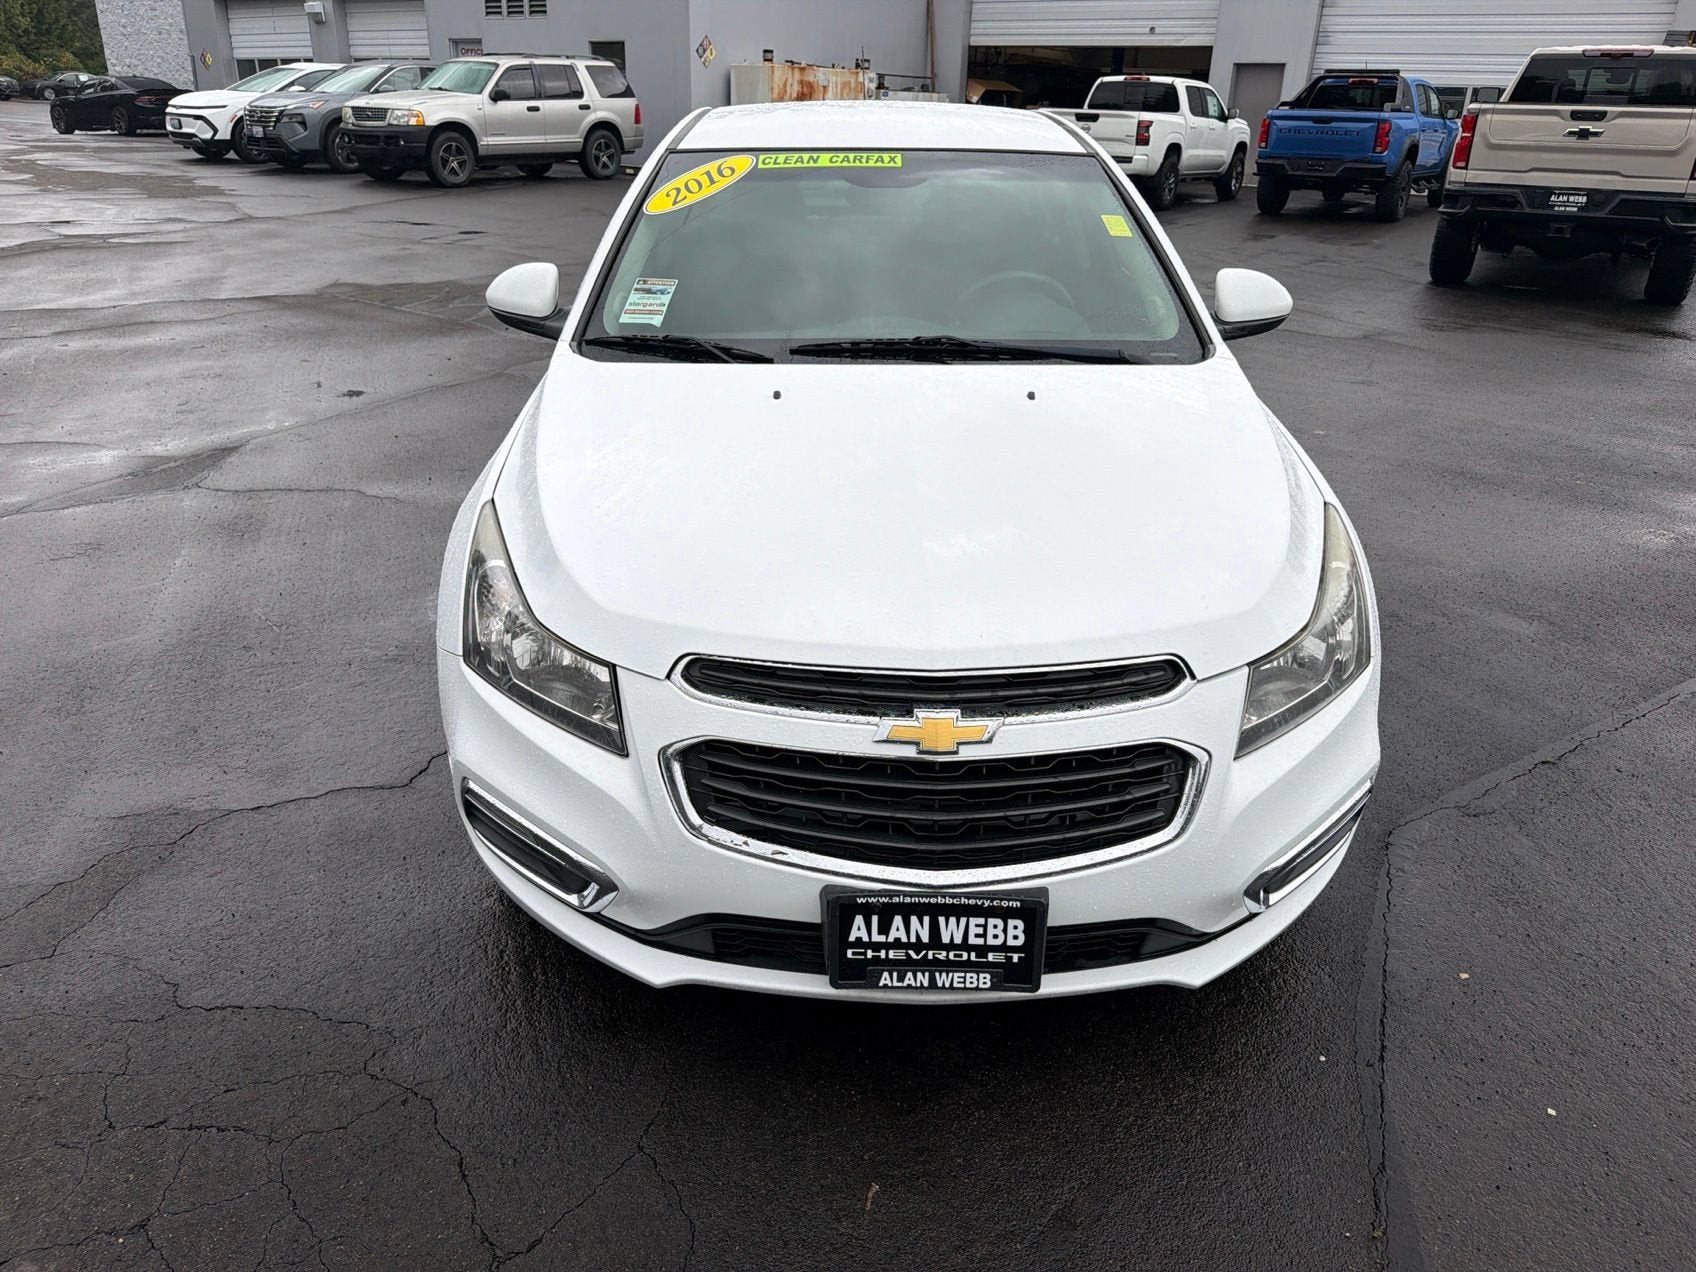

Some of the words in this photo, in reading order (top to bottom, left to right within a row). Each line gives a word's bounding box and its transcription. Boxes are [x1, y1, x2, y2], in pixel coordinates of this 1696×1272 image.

[1280, 128, 1360, 136] CHEVROLET
[761, 156, 819, 166] CLEAN
[829, 154, 899, 164] CARFAX
[665, 161, 736, 206] 2016
[856, 896, 1021, 908] www.alanwebbchevy.com
[848, 915, 930, 943] ALAN
[938, 916, 1026, 946] WEBB
[847, 949, 1025, 962] CHEVROLET
[879, 972, 930, 987] ALAN
[935, 972, 991, 989] WEBB
